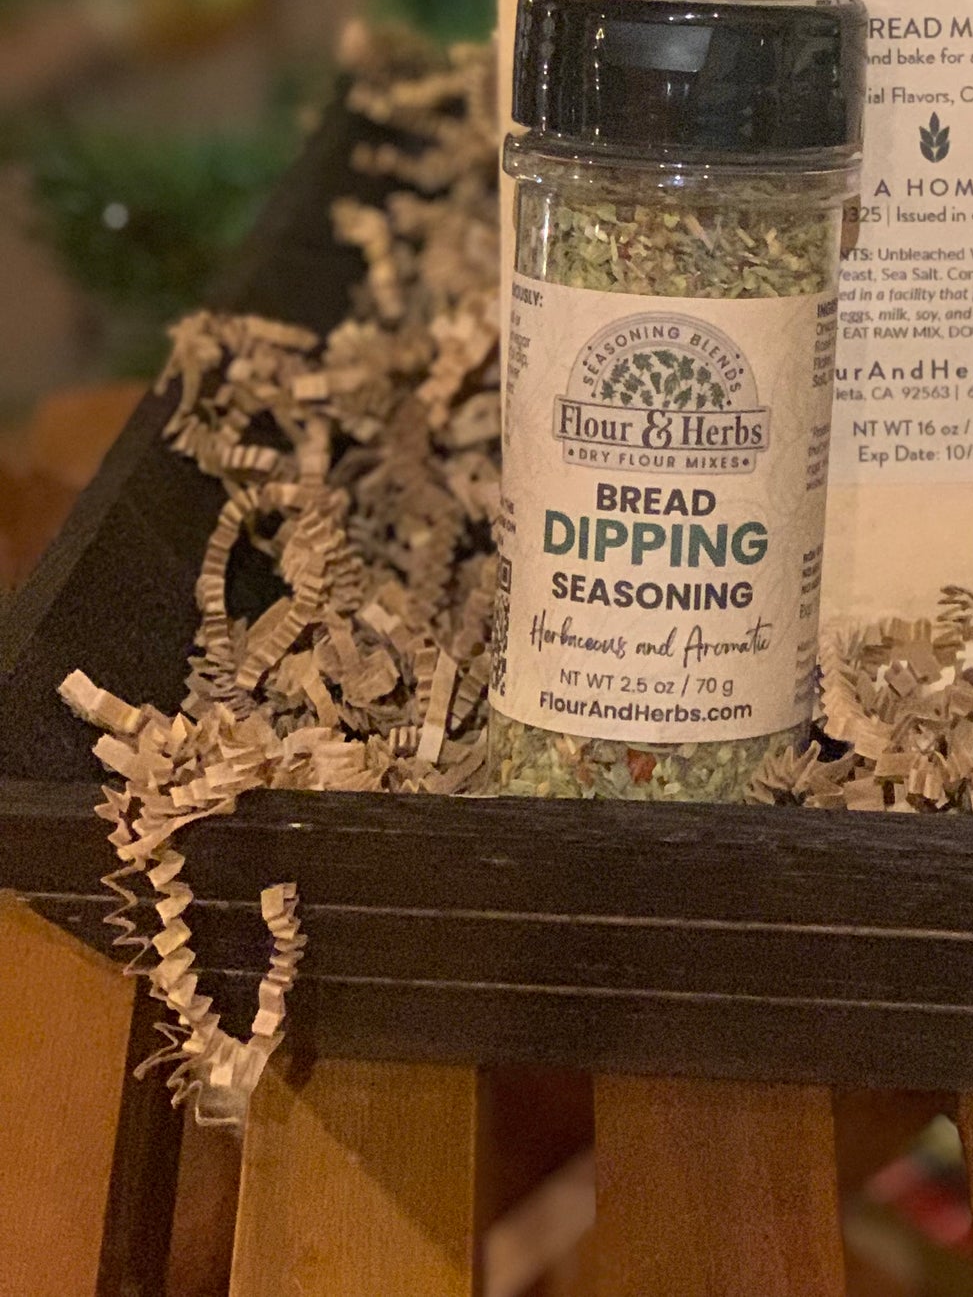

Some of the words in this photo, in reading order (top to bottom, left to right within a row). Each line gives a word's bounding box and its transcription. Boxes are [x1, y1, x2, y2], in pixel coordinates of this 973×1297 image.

[897, 47, 935, 64] bake
[940, 47, 965, 64] for
[892, 86, 955, 105] Flavors,
[874, 179, 892, 197] A
[896, 205, 947, 222] Issued
[952, 205, 966, 222] in
[878, 247, 965, 261] Unbleached
[881, 267, 907, 282] Sea
[859, 287, 872, 301] in
[876, 290, 884, 301] a
[888, 287, 936, 303] facility
[939, 287, 968, 301] that
[878, 307, 911, 322] milk,
[945, 306, 972, 321] and
[843, 326, 869, 339] EAT
[873, 325, 909, 339] RAW
[582, 326, 681, 386] SEASONING
[690, 333, 742, 393] BLENDS
[872, 386, 894, 400] CA
[902, 384, 950, 400] 92563
[559, 404, 633, 443] Flour
[641, 409, 673, 449] &
[680, 413, 763, 446] Herbs
[853, 419, 878, 437] NT
[884, 419, 913, 436] WT
[918, 419, 936, 436] 16
[941, 424, 959, 436] oz
[579, 448, 611, 463] DRY
[619, 453, 676, 468] FLOUR
[686, 455, 740, 469] MIXES
[858, 446, 889, 467] Exp
[895, 444, 941, 462] Date:
[596, 482, 717, 517] BREAD
[543, 509, 768, 568] DIPPING
[552, 571, 753, 611] SEASONING
[530, 609, 628, 660] Herbaceous
[635, 625, 678, 658] and
[683, 616, 773, 669] Aromatic
[560, 668, 582, 686] NT
[586, 672, 615, 691] WT
[620, 675, 648, 694] 2.5
[654, 681, 675, 695] oz
[696, 677, 718, 694] 70
[722, 678, 734, 697] g
[539, 690, 753, 723] FlourAndHerbs.com
